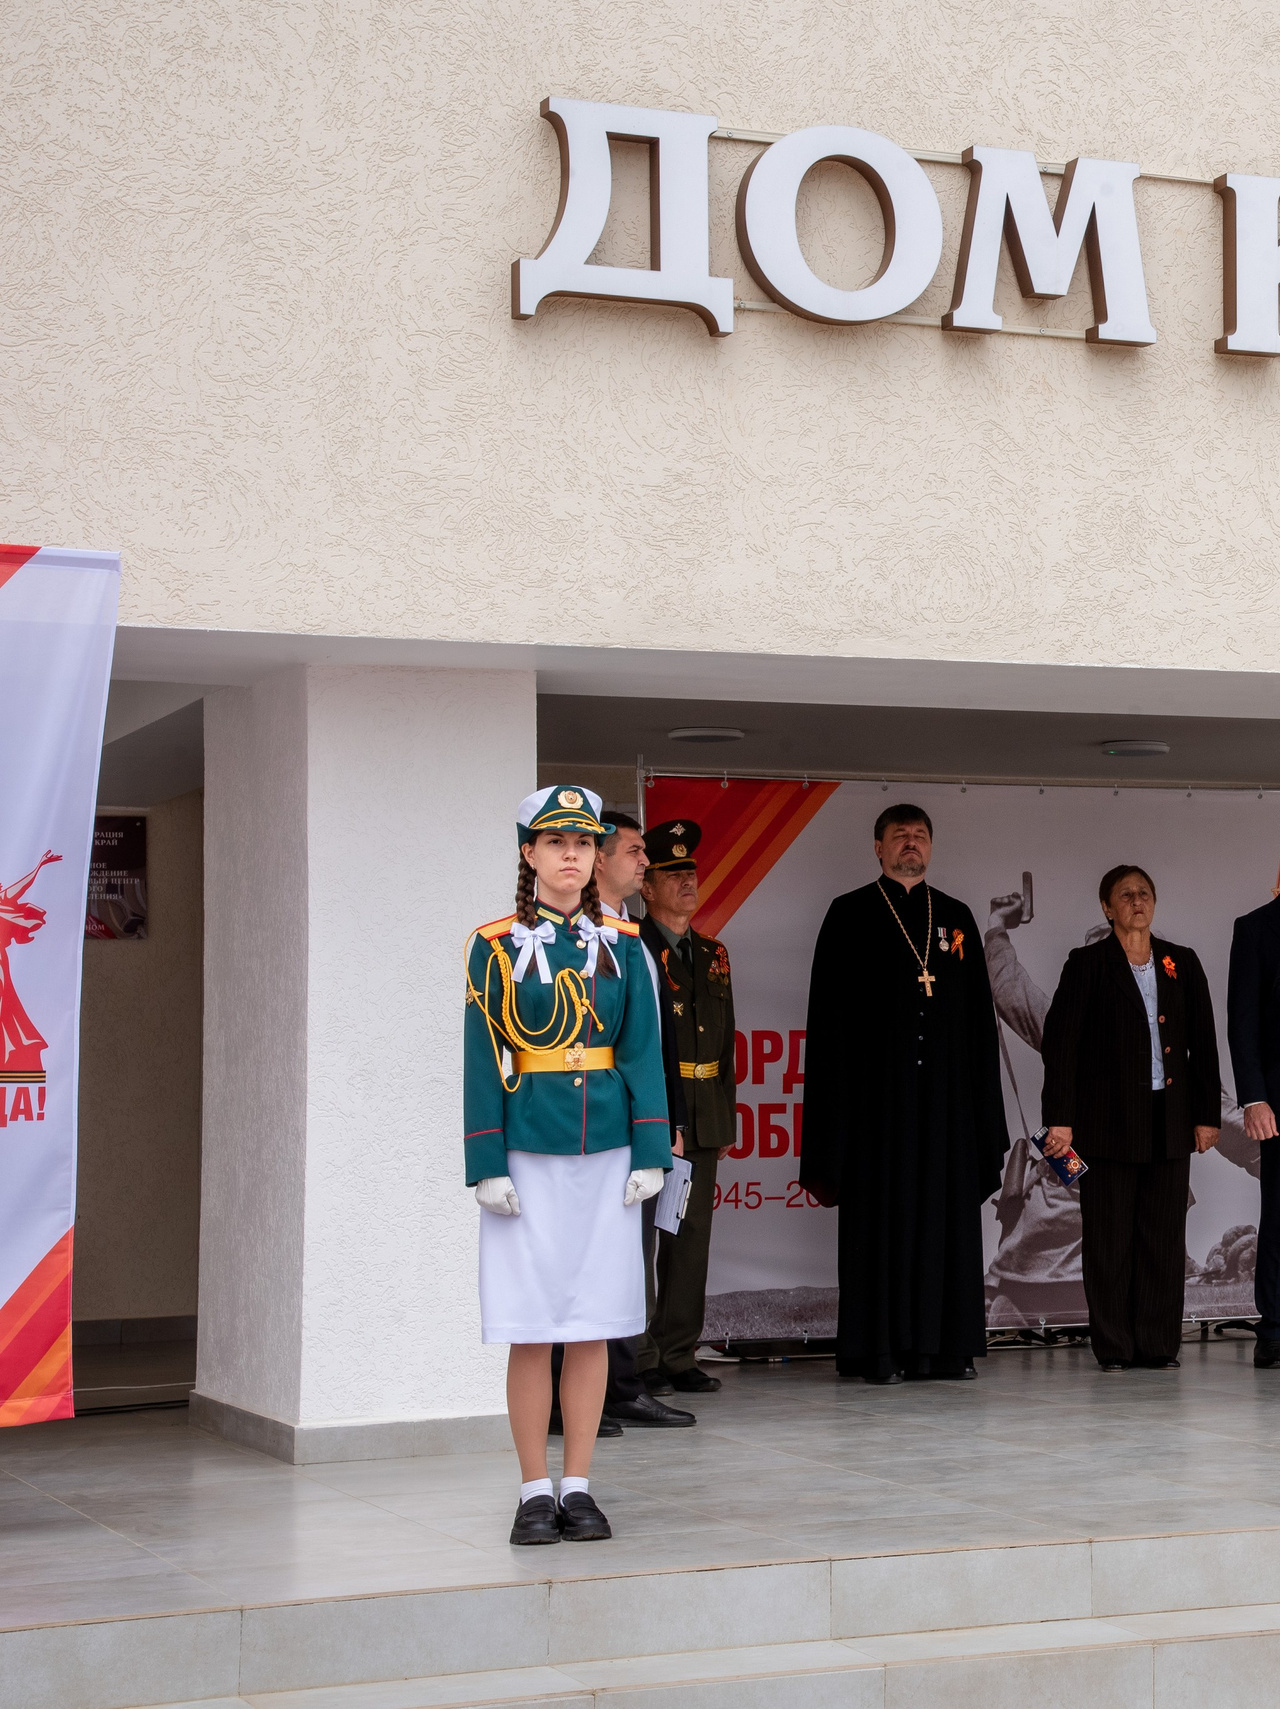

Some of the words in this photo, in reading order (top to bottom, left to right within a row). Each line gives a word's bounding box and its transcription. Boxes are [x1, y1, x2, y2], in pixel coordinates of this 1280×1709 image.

[511, 96, 1156, 348] ДОМ
[94, 838, 118, 846] КРАЙ
[111, 877, 140, 885] ЦЕНТР
[0, 1086, 46, 1128] А!
[727, 1102, 804, 1159] ОБ
